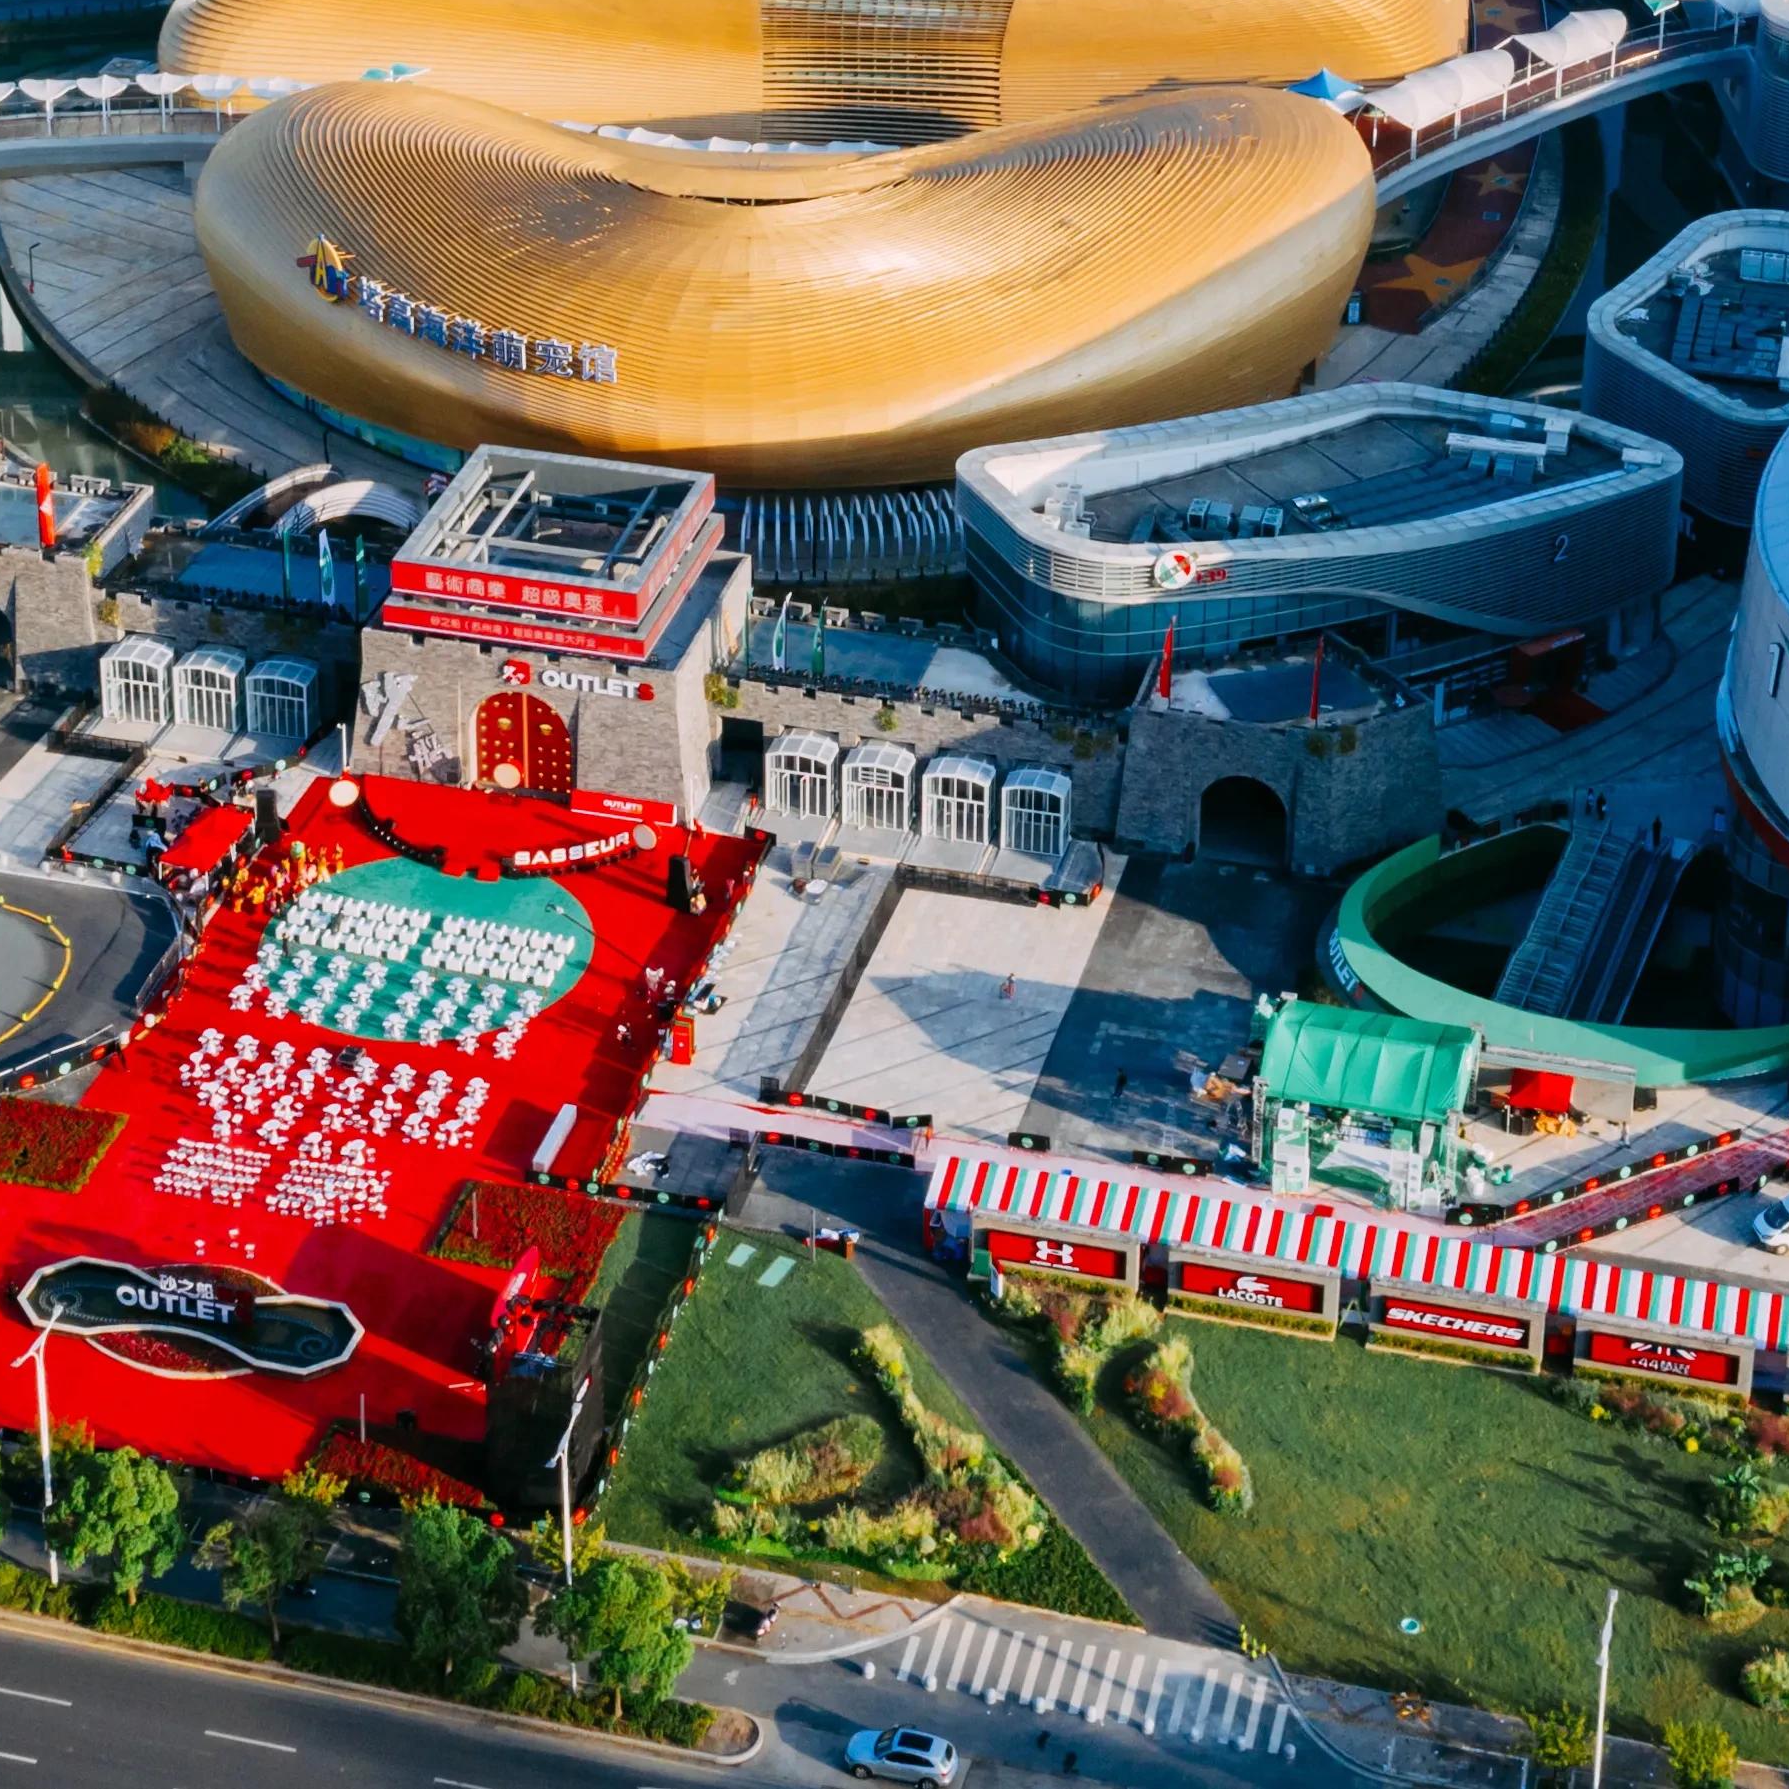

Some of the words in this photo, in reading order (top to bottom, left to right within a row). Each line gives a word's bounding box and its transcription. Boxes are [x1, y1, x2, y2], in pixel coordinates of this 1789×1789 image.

[1554, 534, 1570, 562] 2
[542, 669, 655, 701] OUTLETS
[1769, 642, 1783, 697] 1
[514, 831, 630, 865] SASSEUR
[1218, 1287, 1283, 1308] LACOSTE
[1387, 1307, 1525, 1341] SKECHERS
